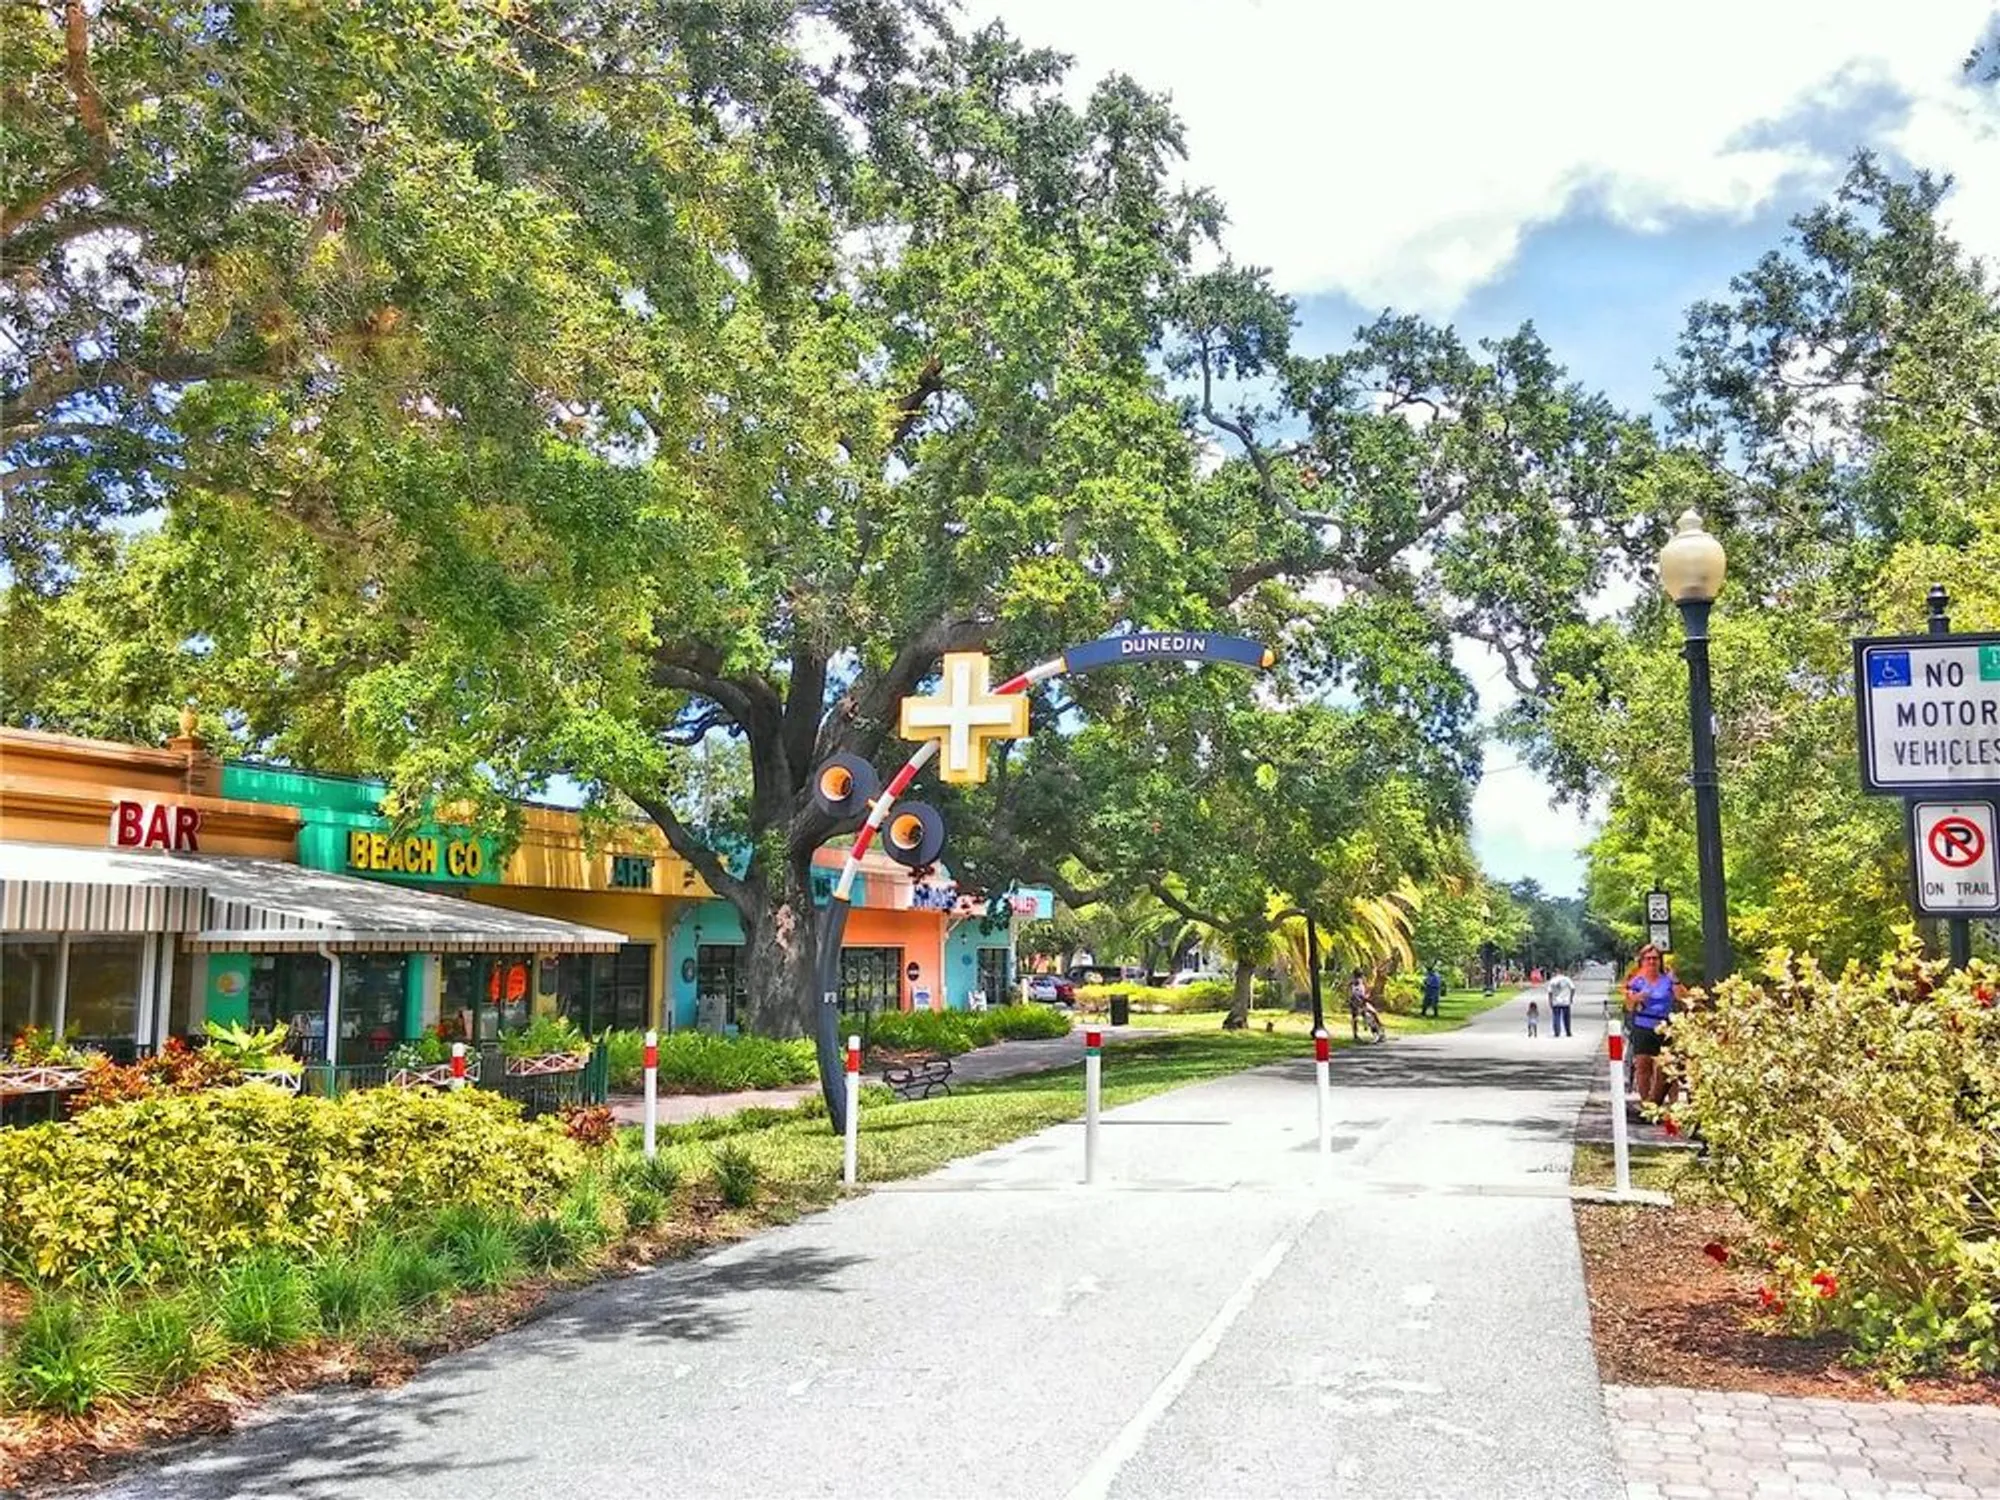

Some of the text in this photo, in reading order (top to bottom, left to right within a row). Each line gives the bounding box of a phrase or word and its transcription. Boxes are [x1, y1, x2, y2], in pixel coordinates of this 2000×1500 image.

[1121, 637, 1206, 653] DUNEDIN
[1925, 661, 1964, 687] NO
[1897, 700, 1998, 727] MOTOR
[116, 800, 199, 851] BAR
[350, 831, 483, 877] BEACH CO
[609, 855, 655, 888] ART
[1926, 882, 1994, 895] ON TRAIL
[1651, 908, 1668, 919] 20
